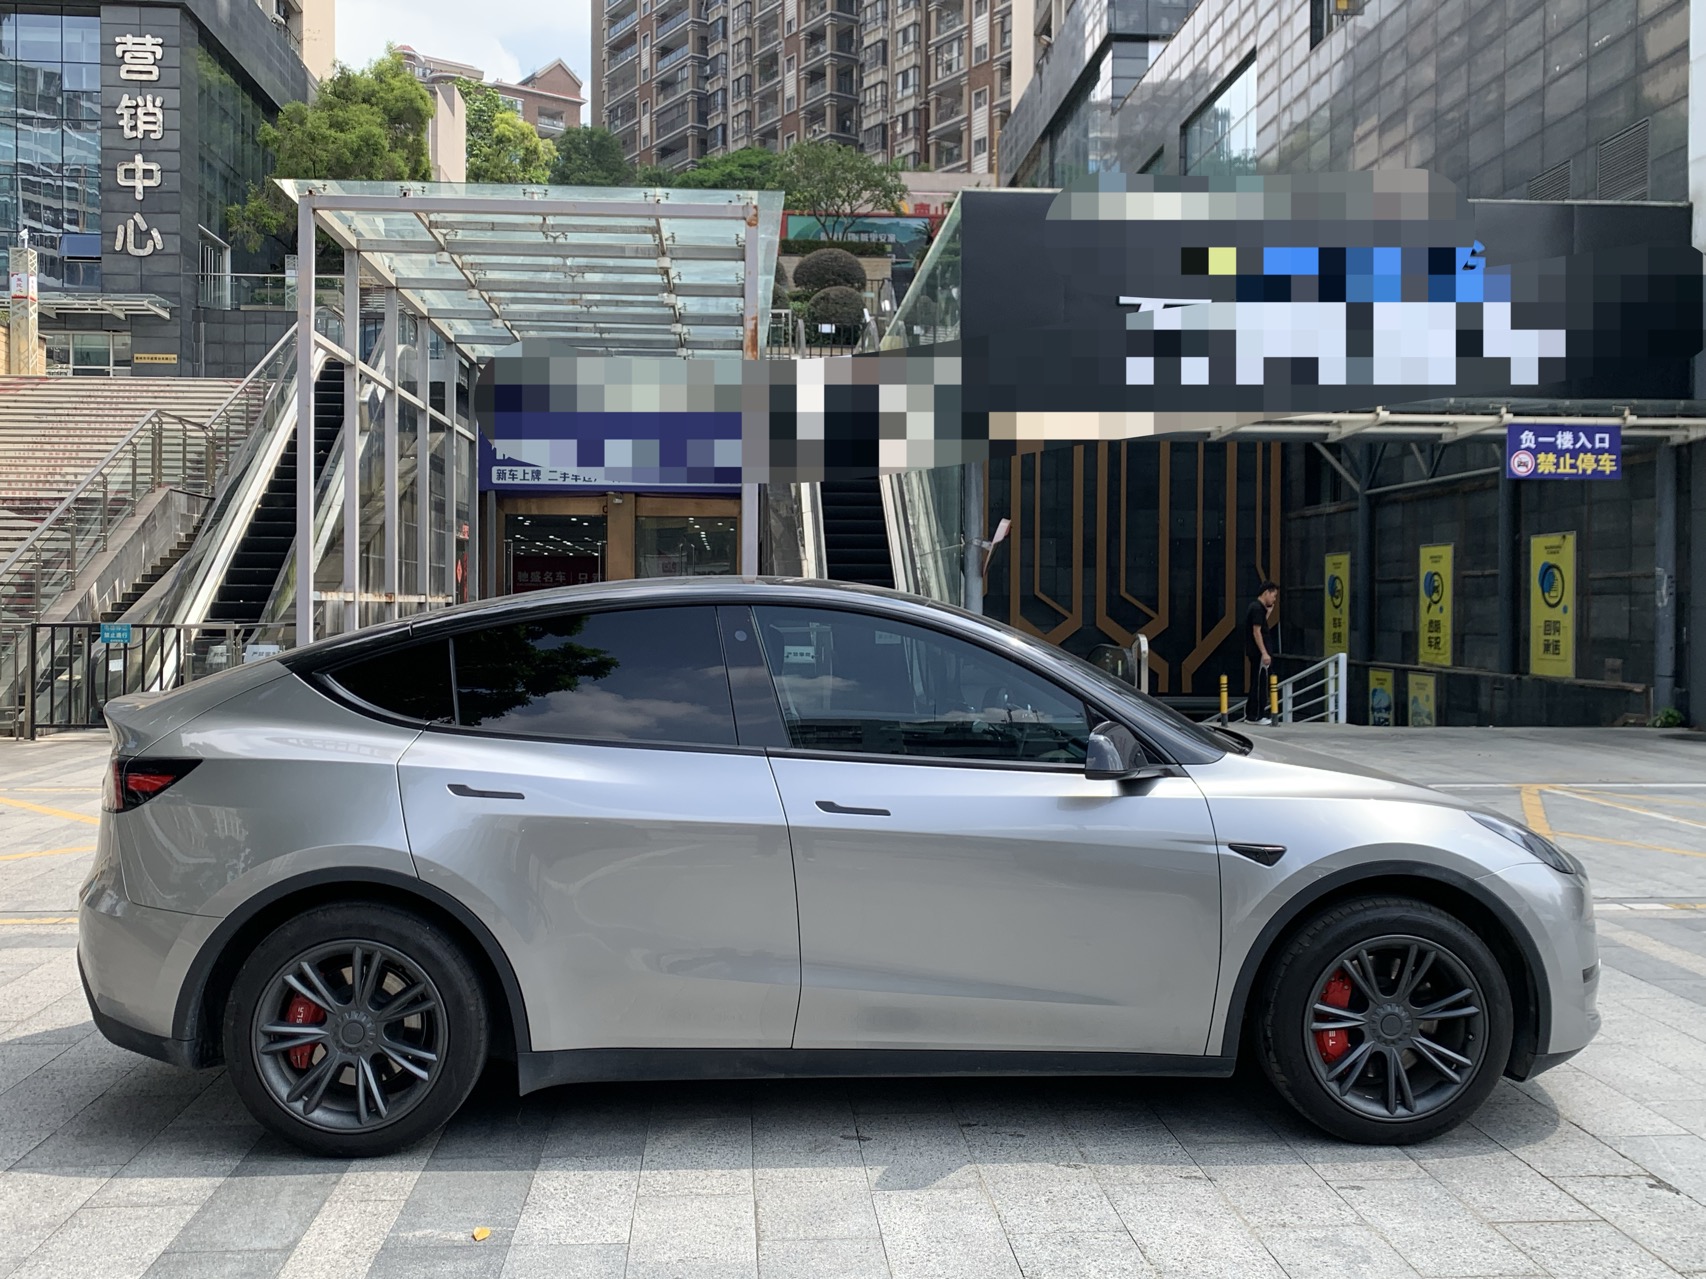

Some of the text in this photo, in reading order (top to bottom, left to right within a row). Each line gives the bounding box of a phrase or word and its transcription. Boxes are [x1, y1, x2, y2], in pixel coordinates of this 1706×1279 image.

[115, 33, 164, 257] 营销中心
[1520, 430, 1610, 450] 负一楼入口
[1536, 452, 1618, 475] 禁止停车
[496, 469, 542, 482] 新车上牌
